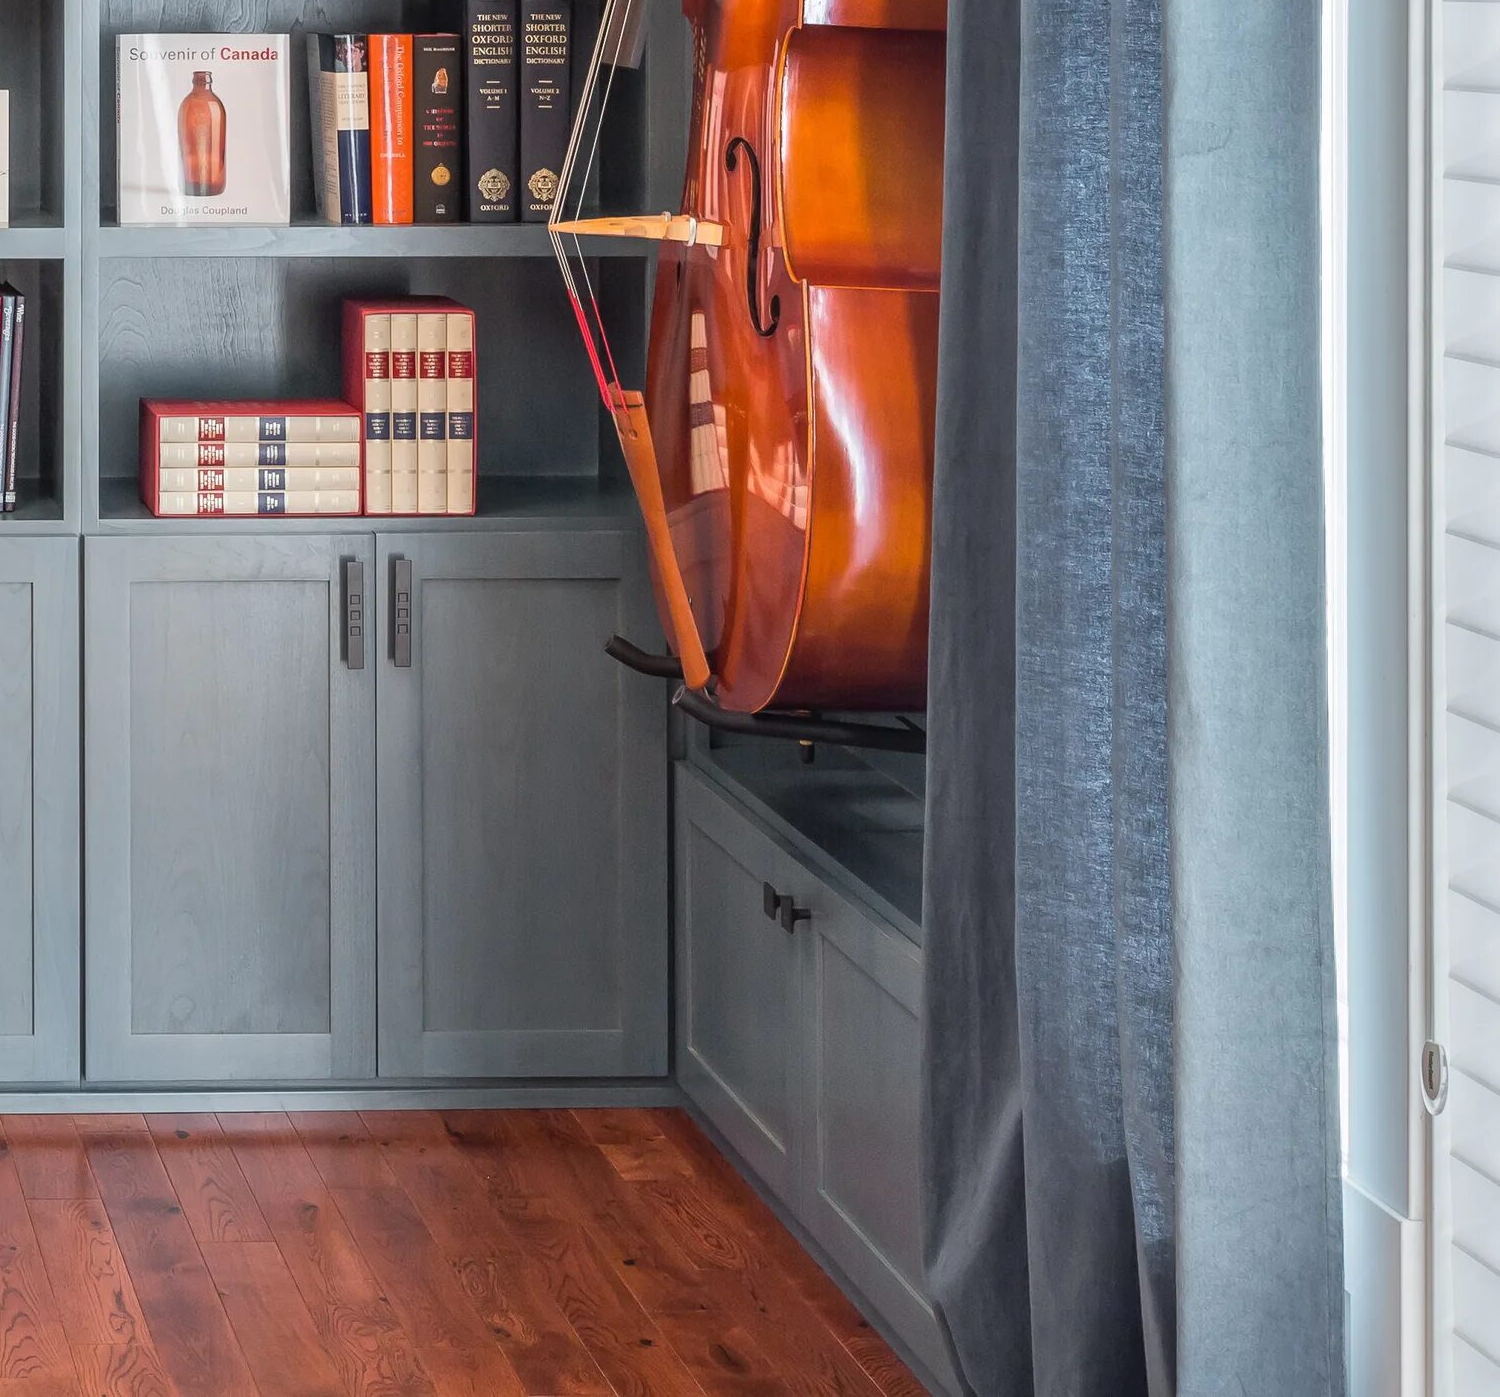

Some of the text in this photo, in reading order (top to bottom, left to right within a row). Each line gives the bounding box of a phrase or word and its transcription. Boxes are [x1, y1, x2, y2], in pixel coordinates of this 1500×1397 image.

[473, 24, 512, 32] SHORTER
[525, 24, 566, 32] SHORTER
[472, 35, 513, 44] OXFORD
[525, 35, 567, 44] OXFORD
[200, 46, 216, 61] of
[220, 46, 279, 61] Canada
[473, 47, 513, 55] ENGLISH
[526, 47, 566, 55] ENGLISH
[160, 205, 248, 217] Doglas Coupland
[16, 304, 24, 323] Wine
